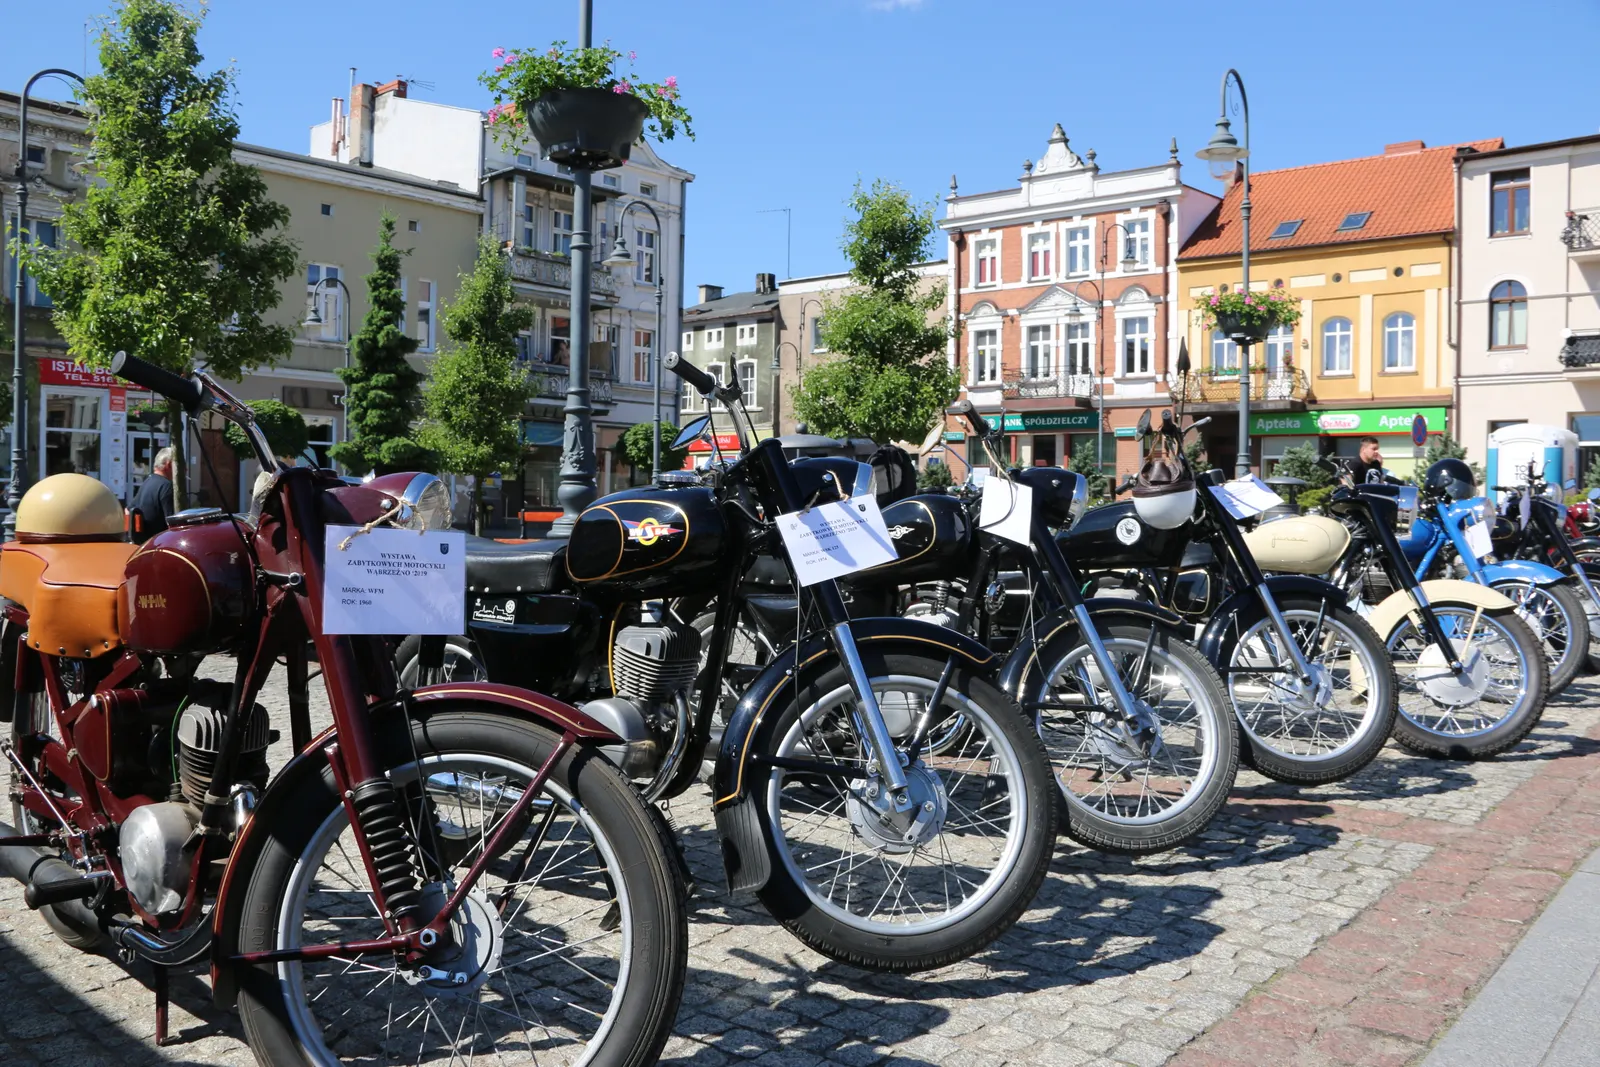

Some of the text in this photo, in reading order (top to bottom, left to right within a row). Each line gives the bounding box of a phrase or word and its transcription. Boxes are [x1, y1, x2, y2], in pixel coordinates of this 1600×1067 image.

[1000, 416, 1089, 427] ANK SPÓŁDZIELCZY
[1256, 417, 1301, 431] Apteka
[1378, 413, 1429, 430] Apte
[380, 552, 416, 560] WYSTAWA
[347, 559, 446, 570] ZABYTKOWYCH MOTOCYKLI
[366, 568, 411, 577] WĄBRZEŹNO
[341, 598, 357, 606] ROK:
